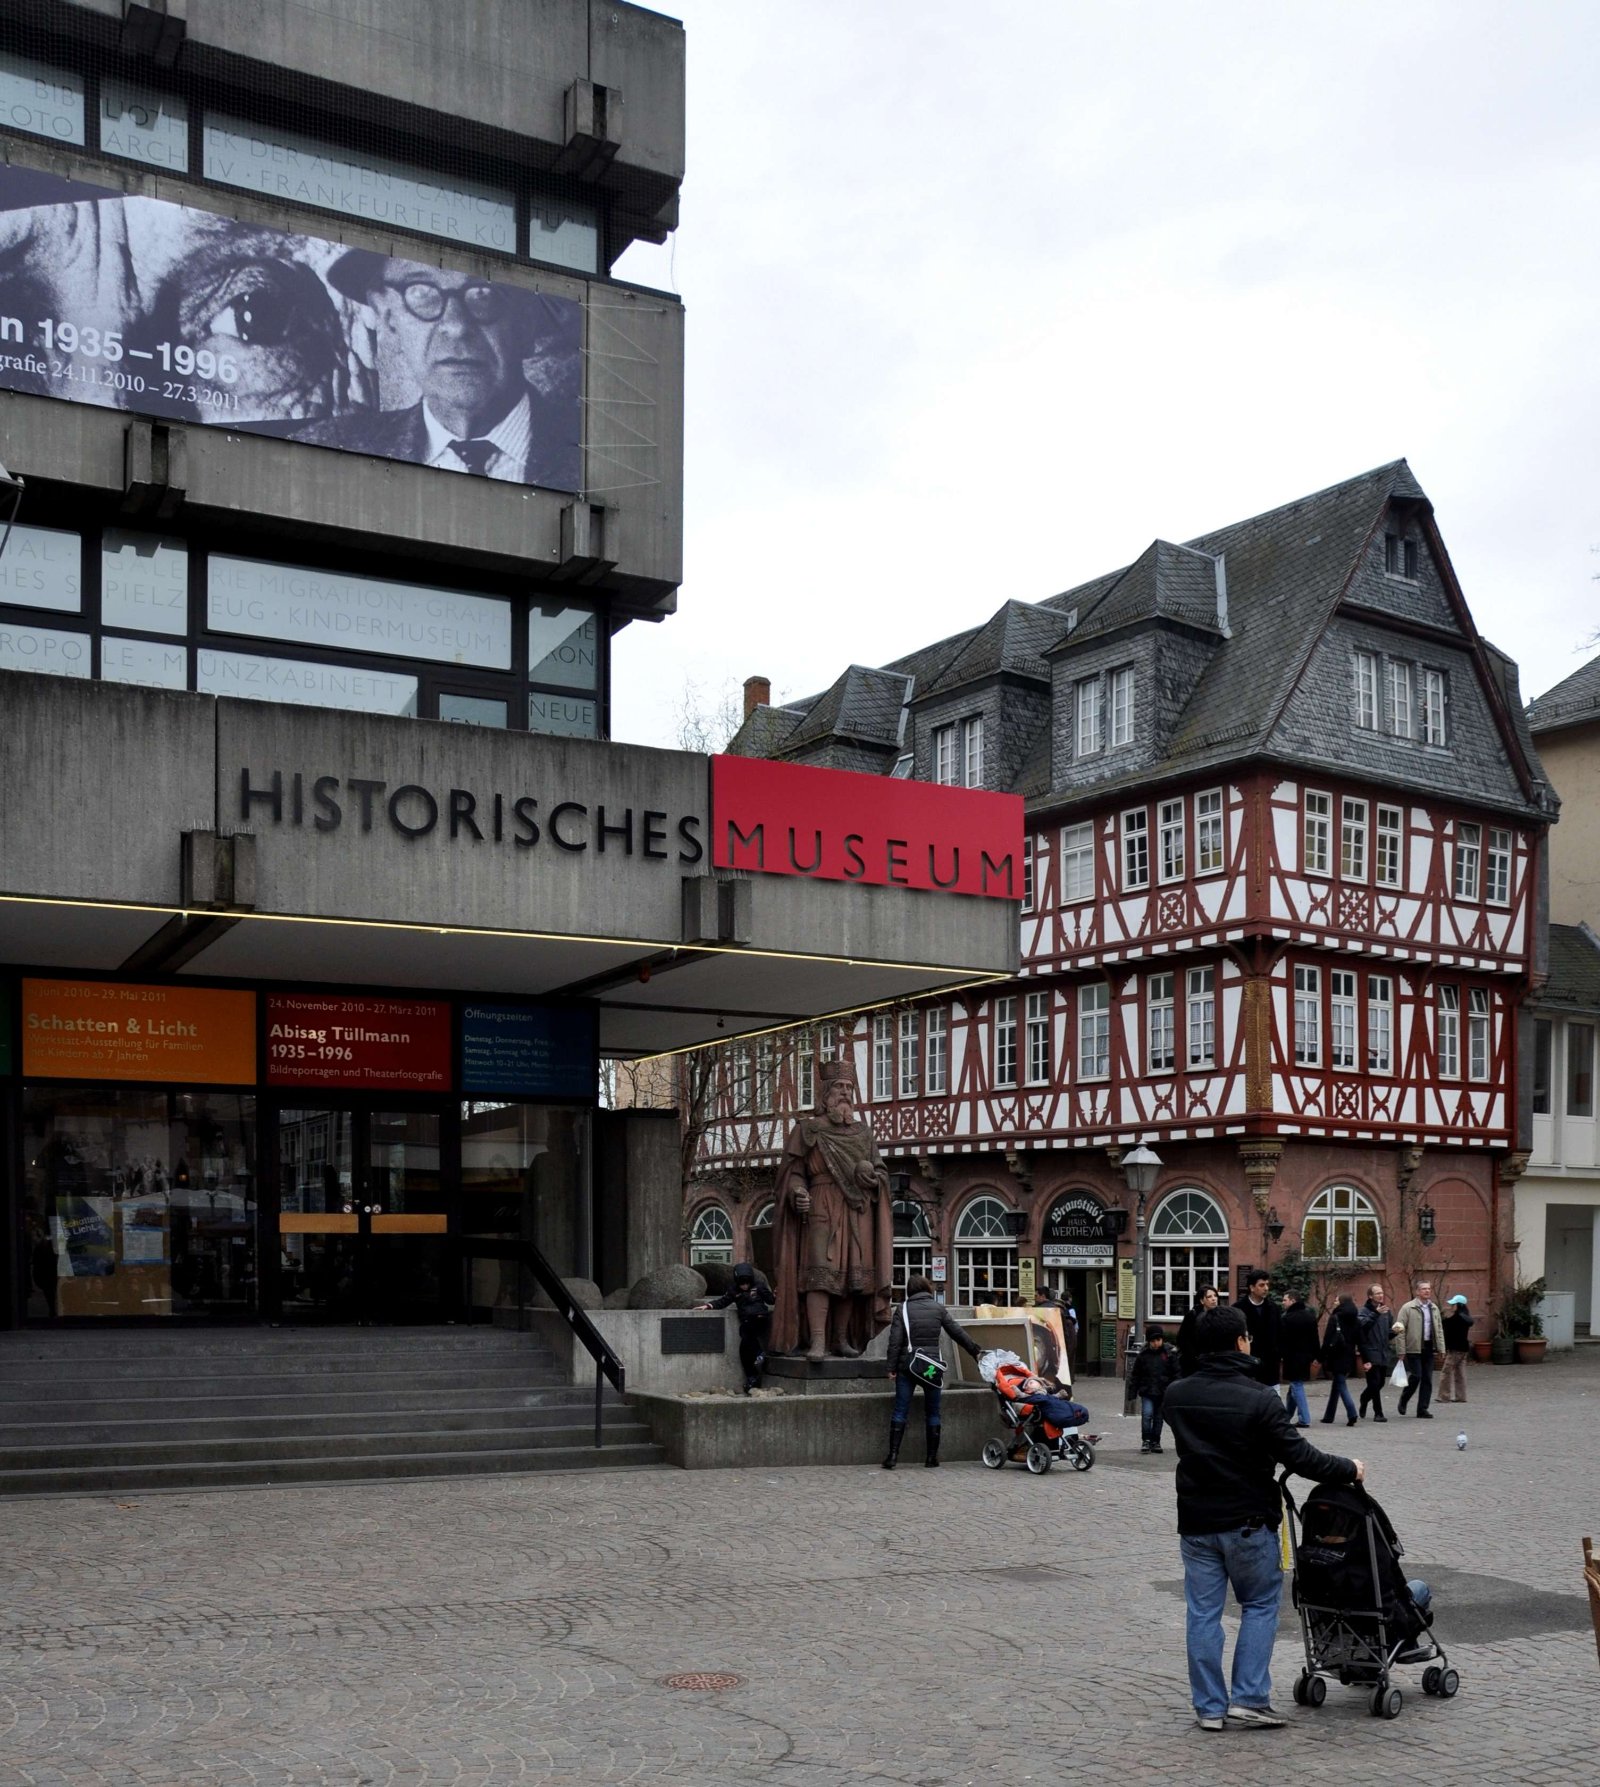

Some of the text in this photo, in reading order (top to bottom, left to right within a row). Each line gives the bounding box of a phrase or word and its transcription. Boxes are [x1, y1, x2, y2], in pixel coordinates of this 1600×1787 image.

[259, 168, 460, 236] FRANKFURTER
[162, 381, 240, 411] 27.3.2011
[259, 573, 405, 613] MIGRATION
[288, 606, 492, 653] KINDERMUSEUM
[530, 699, 594, 725] NEUE
[240, 766, 1014, 898] HISTORISCHES MUSEUM
[286, 1000, 338, 1012] November
[415, 1005, 437, 1017] 2011
[27, 1013, 199, 1038] Schatten & Licht
[269, 1023, 412, 1044] Abisag Tüllmann
[269, 1065, 445, 1082] Bildreportagen und Theaterfotografie
[1052, 1226, 1104, 1238] WERTHEYM
[1044, 1246, 1113, 1256] SPEISERESTAURANT
